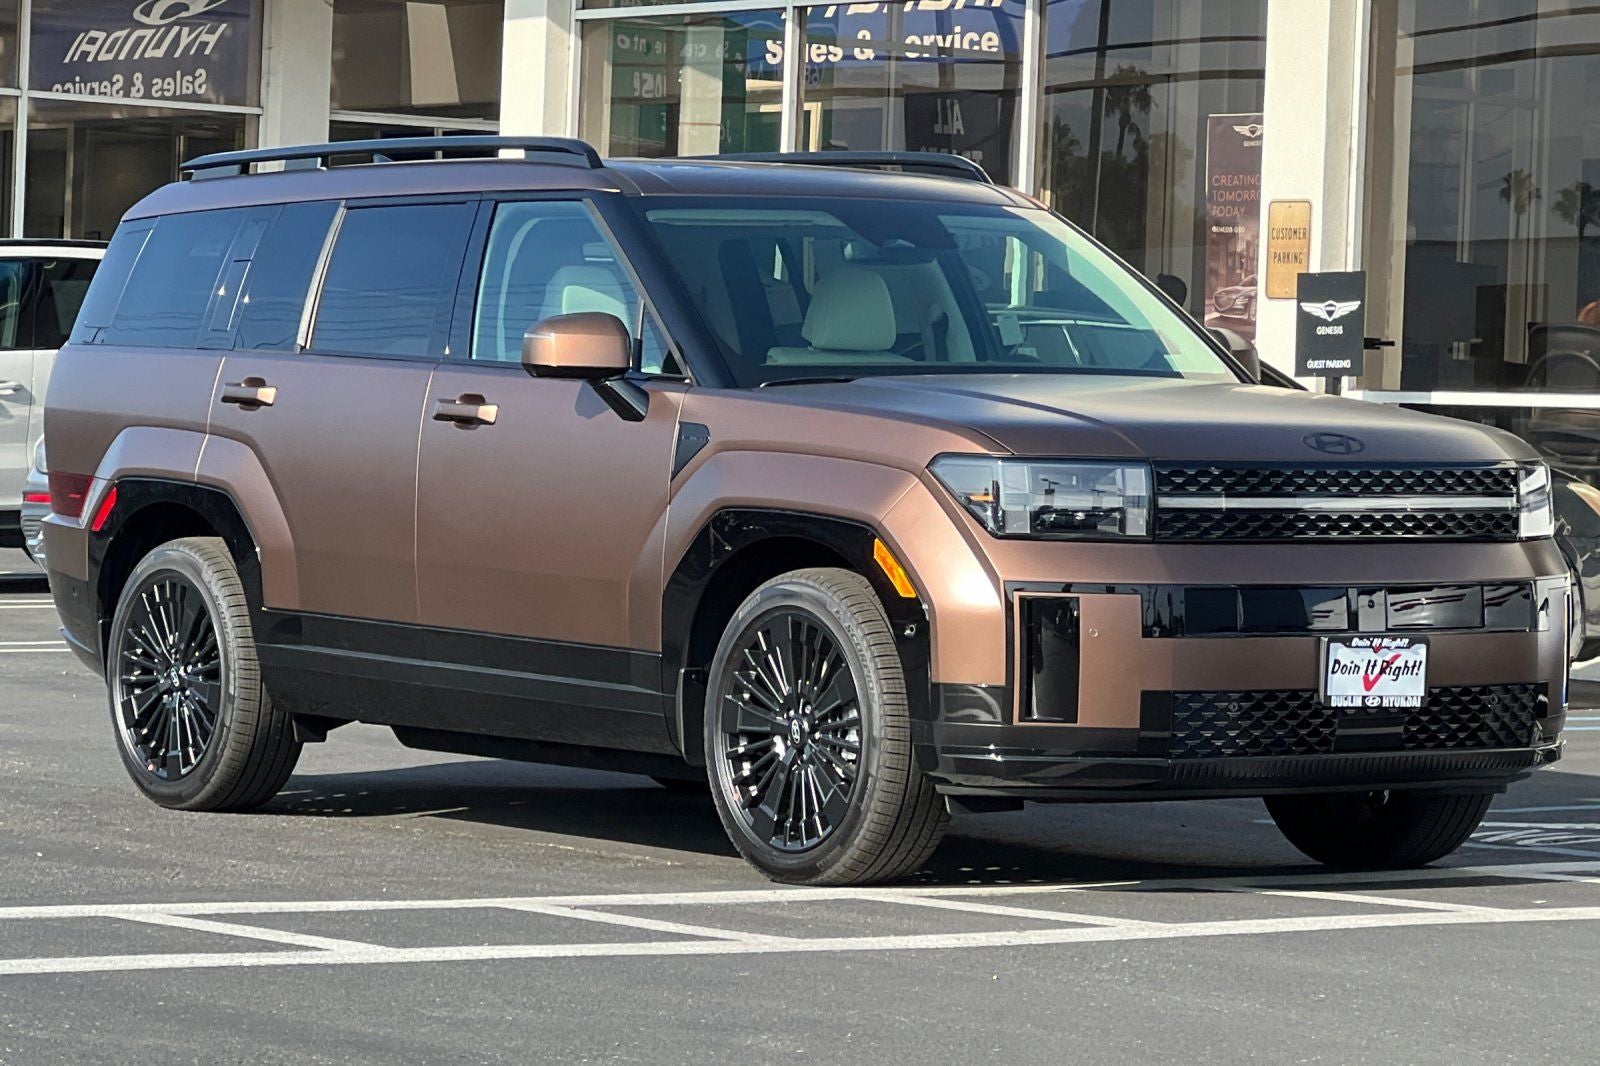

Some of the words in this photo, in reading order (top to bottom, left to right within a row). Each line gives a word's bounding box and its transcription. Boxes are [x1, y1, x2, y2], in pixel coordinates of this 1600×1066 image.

[765, 38, 844, 65] Ses
[854, 29, 875, 60] &
[905, 26, 999, 59] ervice
[1212, 190, 1262, 202] TOMORR
[1271, 227, 1307, 241] CUSTOMER
[1273, 251, 1303, 265] PARKING
[1316, 325, 1343, 335] GENESIS
[1307, 359, 1325, 369] GUEST
[1325, 359, 1351, 369] PARKING
[1365, 659, 1378, 675] It
[1379, 659, 1423, 681] Right!
